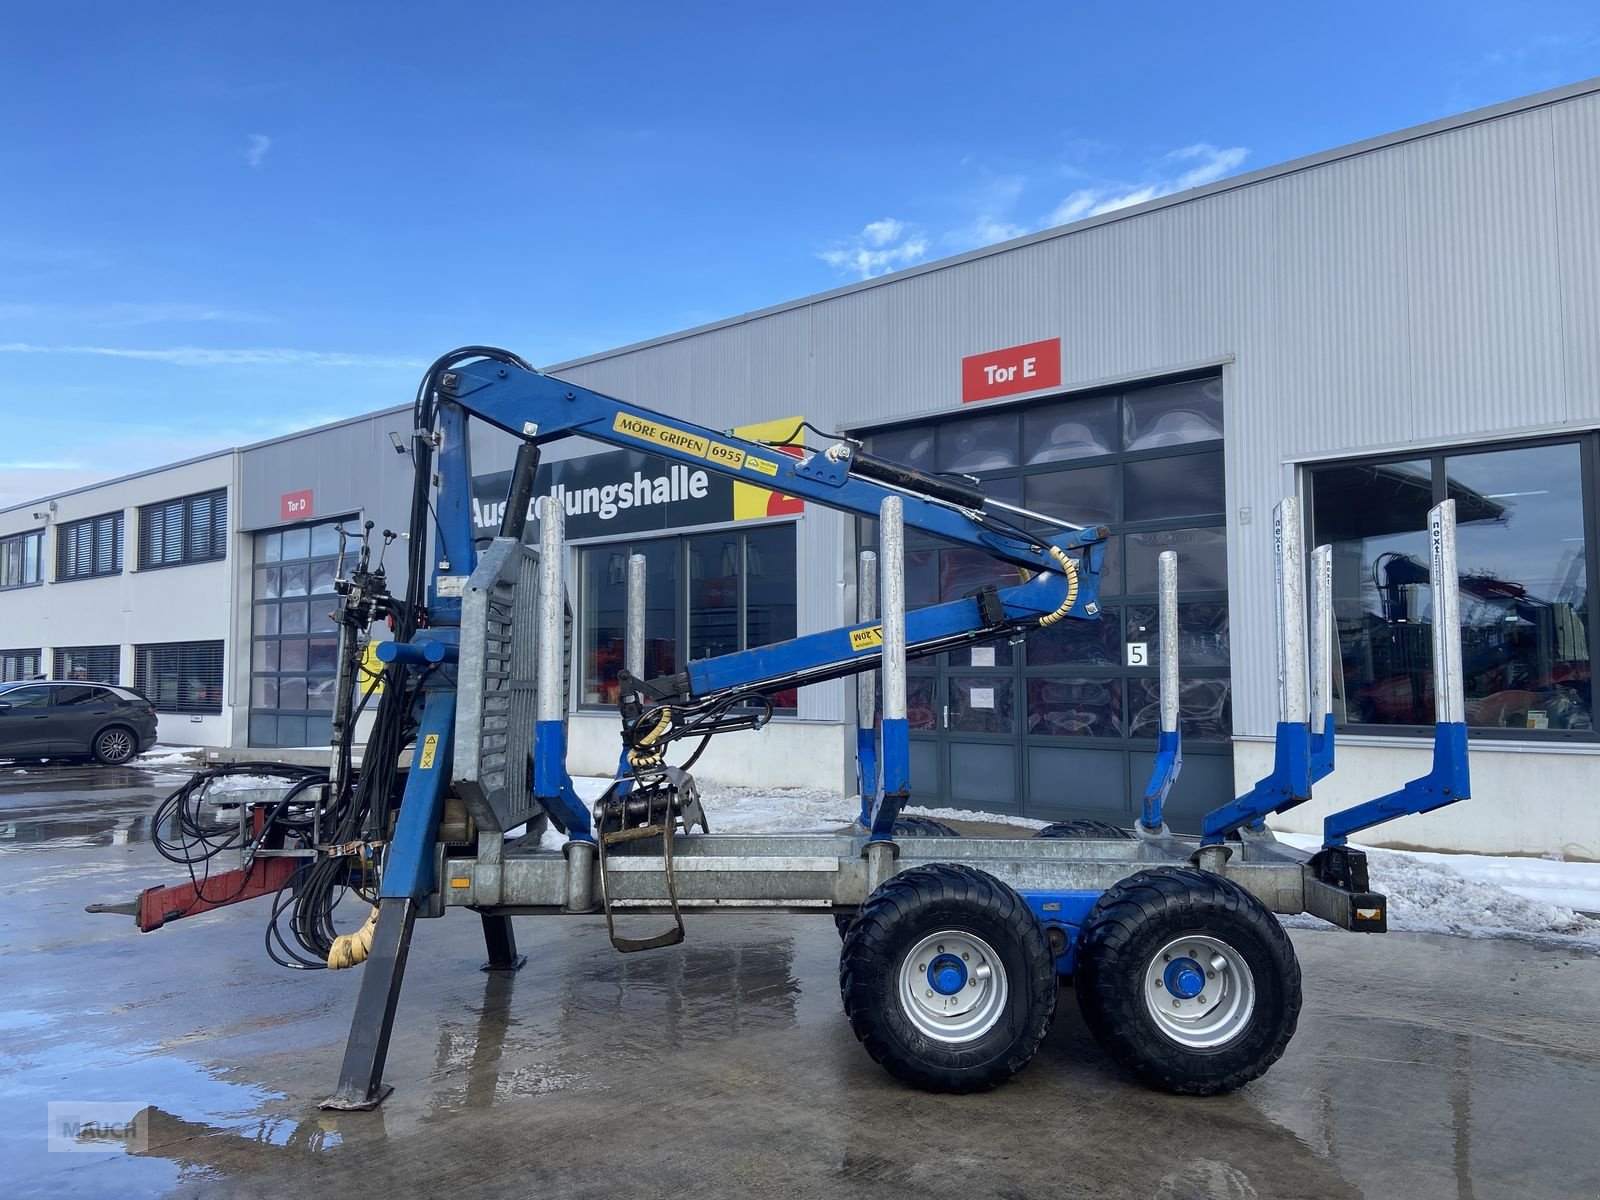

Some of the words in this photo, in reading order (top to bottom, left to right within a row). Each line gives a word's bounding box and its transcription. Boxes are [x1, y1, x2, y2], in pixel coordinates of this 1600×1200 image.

[983, 364, 1017, 385] Tor
[1023, 356, 1037, 378] E
[620, 418, 657, 438] MÖRE
[660, 430, 704, 452] GRIPEN
[711, 446, 742, 463] 6955
[287, 501, 299, 513] Tor
[300, 498, 306, 510] D
[1432, 521, 1440, 553] next
[853, 631, 872, 642] 20M
[1131, 646, 1142, 664] 5
